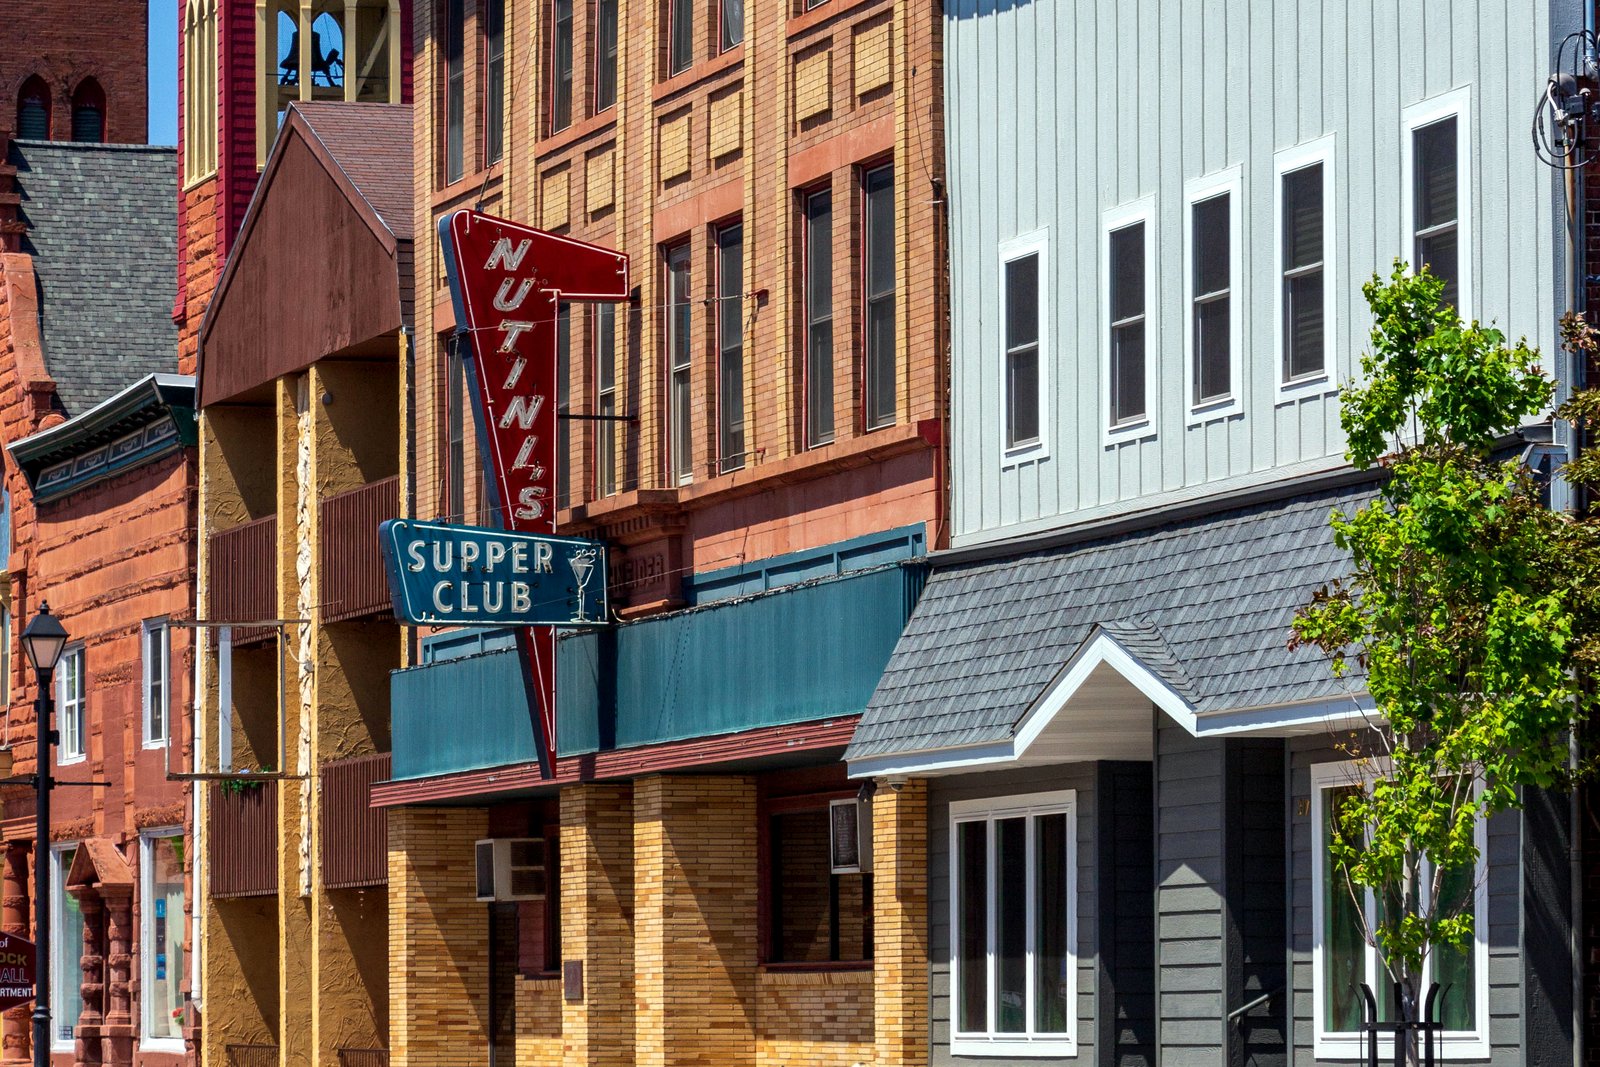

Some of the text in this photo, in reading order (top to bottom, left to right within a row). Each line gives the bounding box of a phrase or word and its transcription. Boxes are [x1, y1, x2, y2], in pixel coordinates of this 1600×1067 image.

[483, 237, 546, 519] NUTINI'S
[407, 539, 554, 574] SUPPER
[432, 580, 532, 613] CLUB
